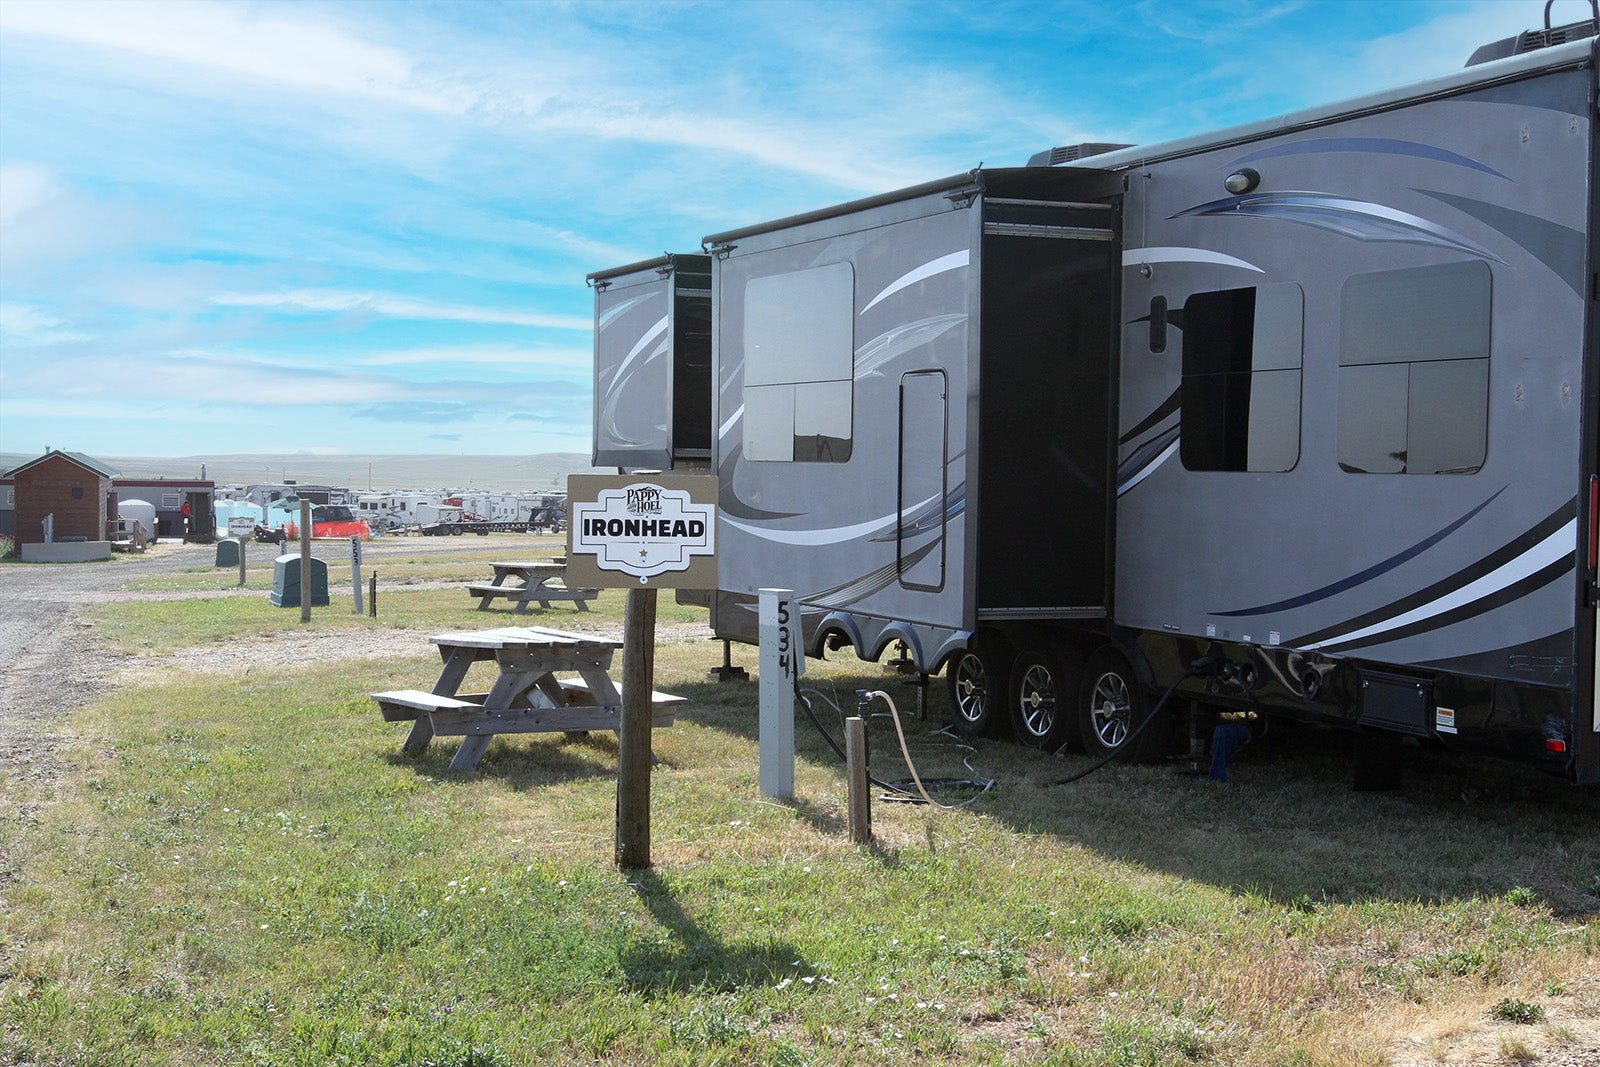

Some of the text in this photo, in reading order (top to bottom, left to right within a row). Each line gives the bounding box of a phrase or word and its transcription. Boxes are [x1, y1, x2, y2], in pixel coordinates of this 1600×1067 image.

[626, 488, 662, 505] PAPPY
[637, 501, 662, 513] HOEL
[583, 518, 705, 538] IRONHEAD
[778, 600, 790, 679] 534
